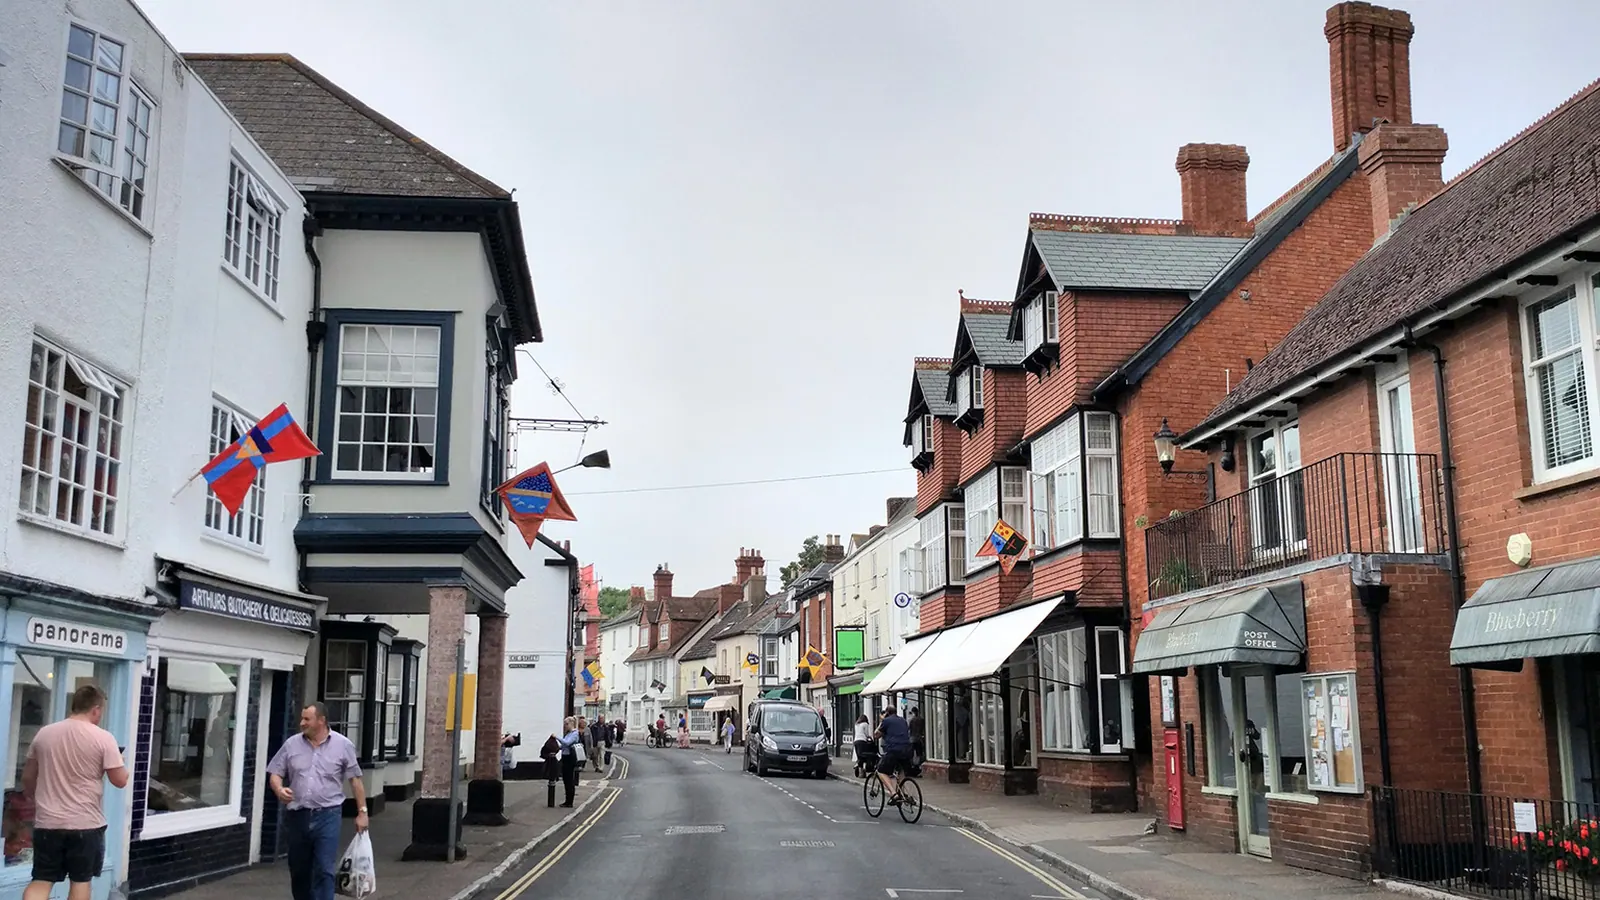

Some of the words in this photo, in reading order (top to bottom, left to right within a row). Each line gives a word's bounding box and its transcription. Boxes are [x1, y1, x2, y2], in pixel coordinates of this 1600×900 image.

[192, 587, 226, 612] ARTHURS
[228, 596, 263, 619] BUTCHERY
[263, 604, 269, 620] &
[270, 605, 312, 627] DELICATESSEN
[1484, 607, 1561, 633] Blueberry
[33, 621, 124, 650] panorama
[1244, 630, 1268, 640] POST
[1245, 639, 1277, 648] OFFICE
